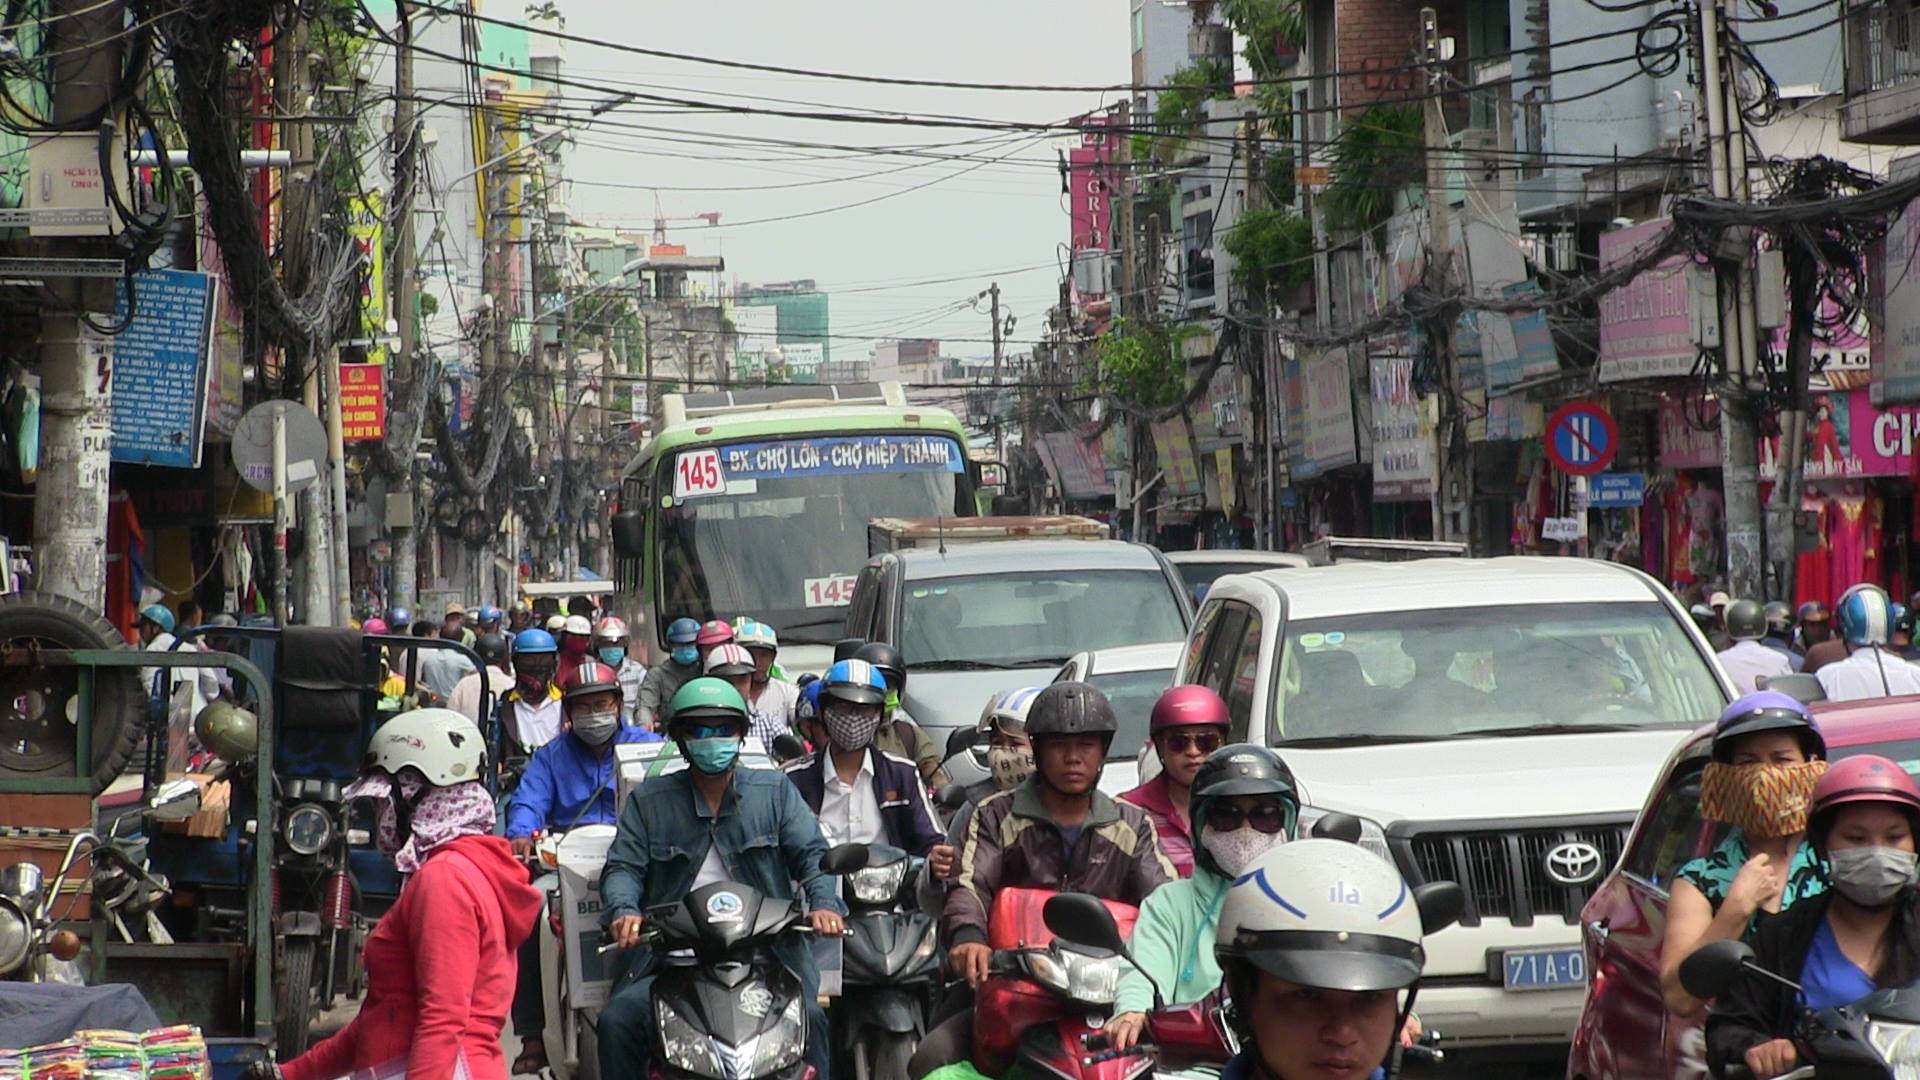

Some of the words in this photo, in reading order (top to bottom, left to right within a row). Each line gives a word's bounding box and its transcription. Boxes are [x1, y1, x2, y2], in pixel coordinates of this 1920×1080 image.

[756, 442, 788, 473] CHỢ
[790, 441, 821, 468] LỚN
[831, 440, 863, 471] CHỢ
[865, 440, 898, 469] HIỆP
[900, 436, 949, 464] THÀNH
[679, 455, 718, 491] 145
[809, 579, 855, 604] 145
